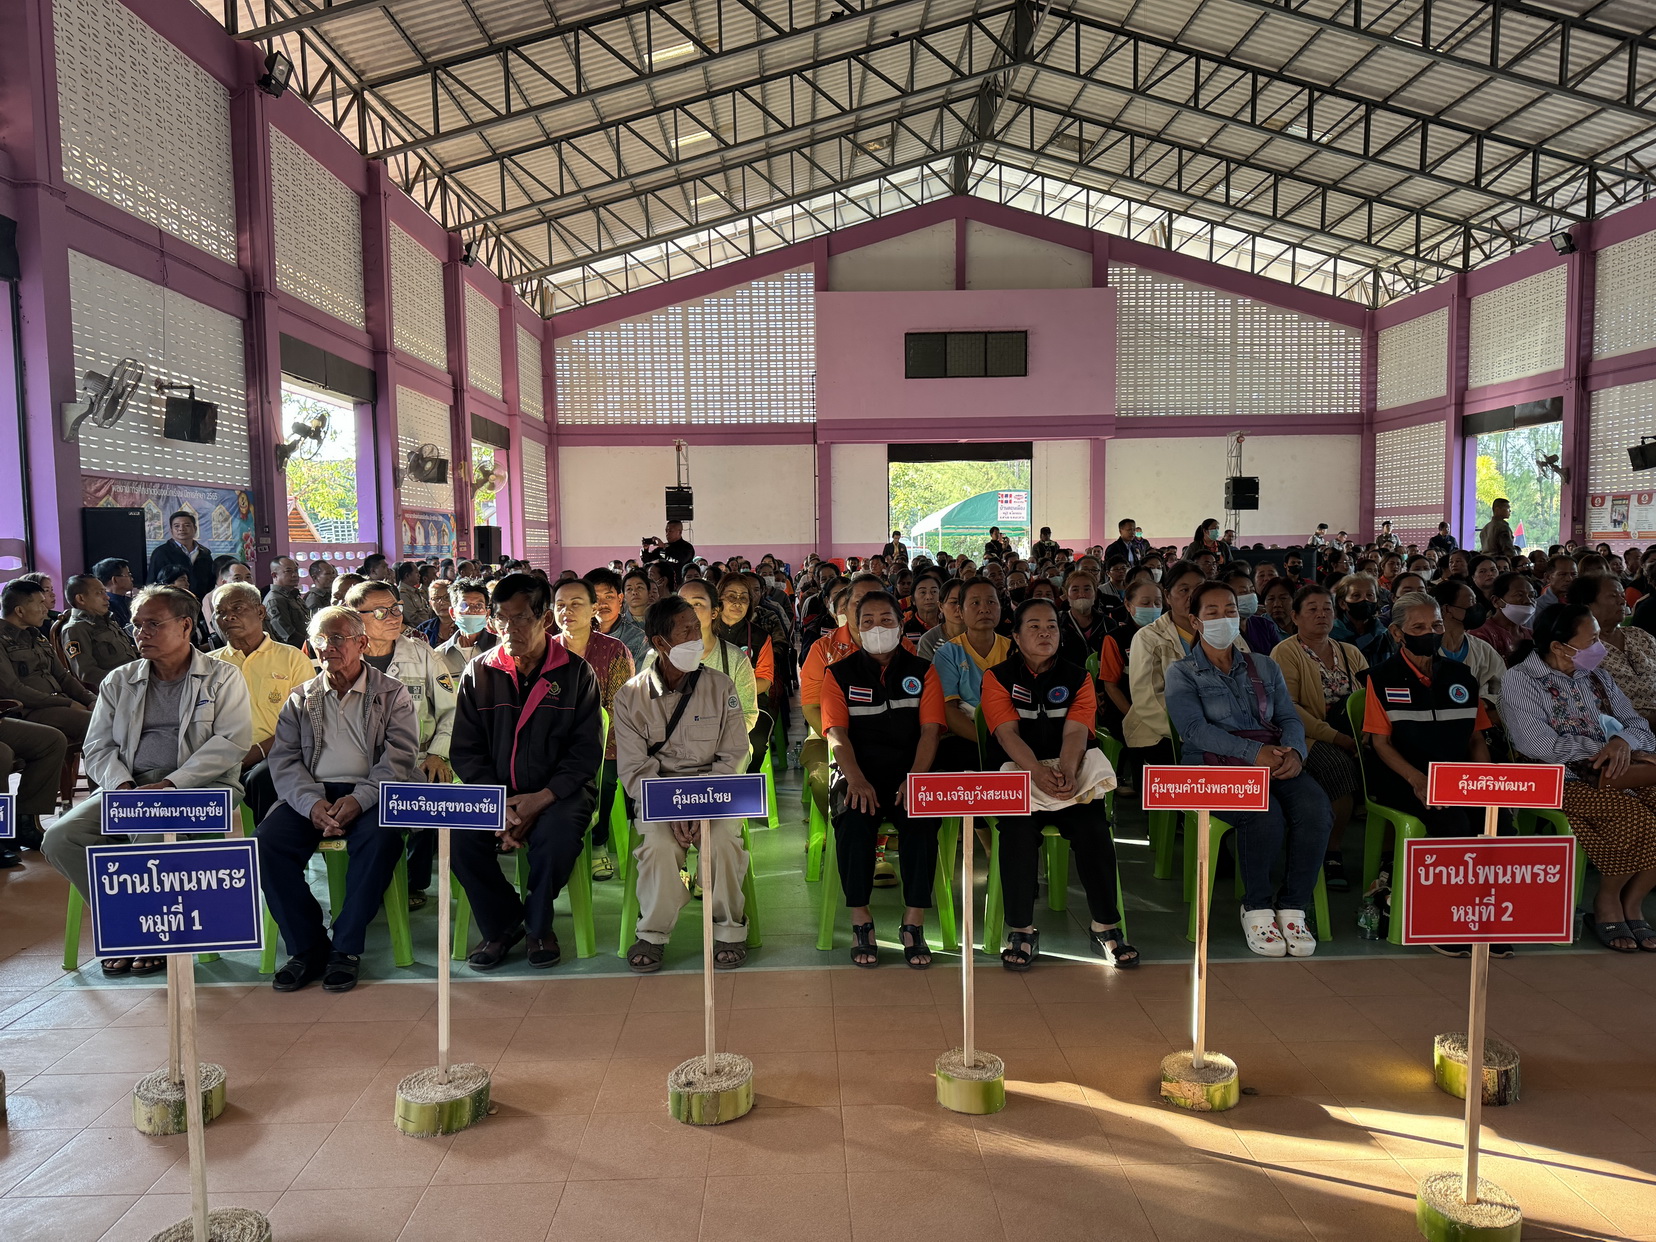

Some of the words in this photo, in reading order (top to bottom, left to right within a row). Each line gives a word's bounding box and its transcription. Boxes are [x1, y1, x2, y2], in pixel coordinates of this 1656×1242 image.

[206, 491, 218, 501] 2565
[917, 785, 934, 807] คุ้ม
[936, 785, 1023, 805] จ.เจริญวังสะแบง
[1458, 774, 1536, 795] คุ้มศิริพัฒนา
[389, 794, 497, 817] คุ้มเจริญสุขทองชัย
[672, 787, 732, 810] คุ้มลมโชย
[109, 801, 223, 823] คุ้มแก้วพัฒนาบุญชัย
[101, 859, 246, 895] บ้านโพนพระ
[1417, 852, 1561, 886] บ้านโพนพระ
[139, 896, 185, 942] หมู่ที่
[191, 909, 203, 931] 1
[1450, 888, 1496, 931] หมู่ที่
[1500, 901, 1514, 922] 2
